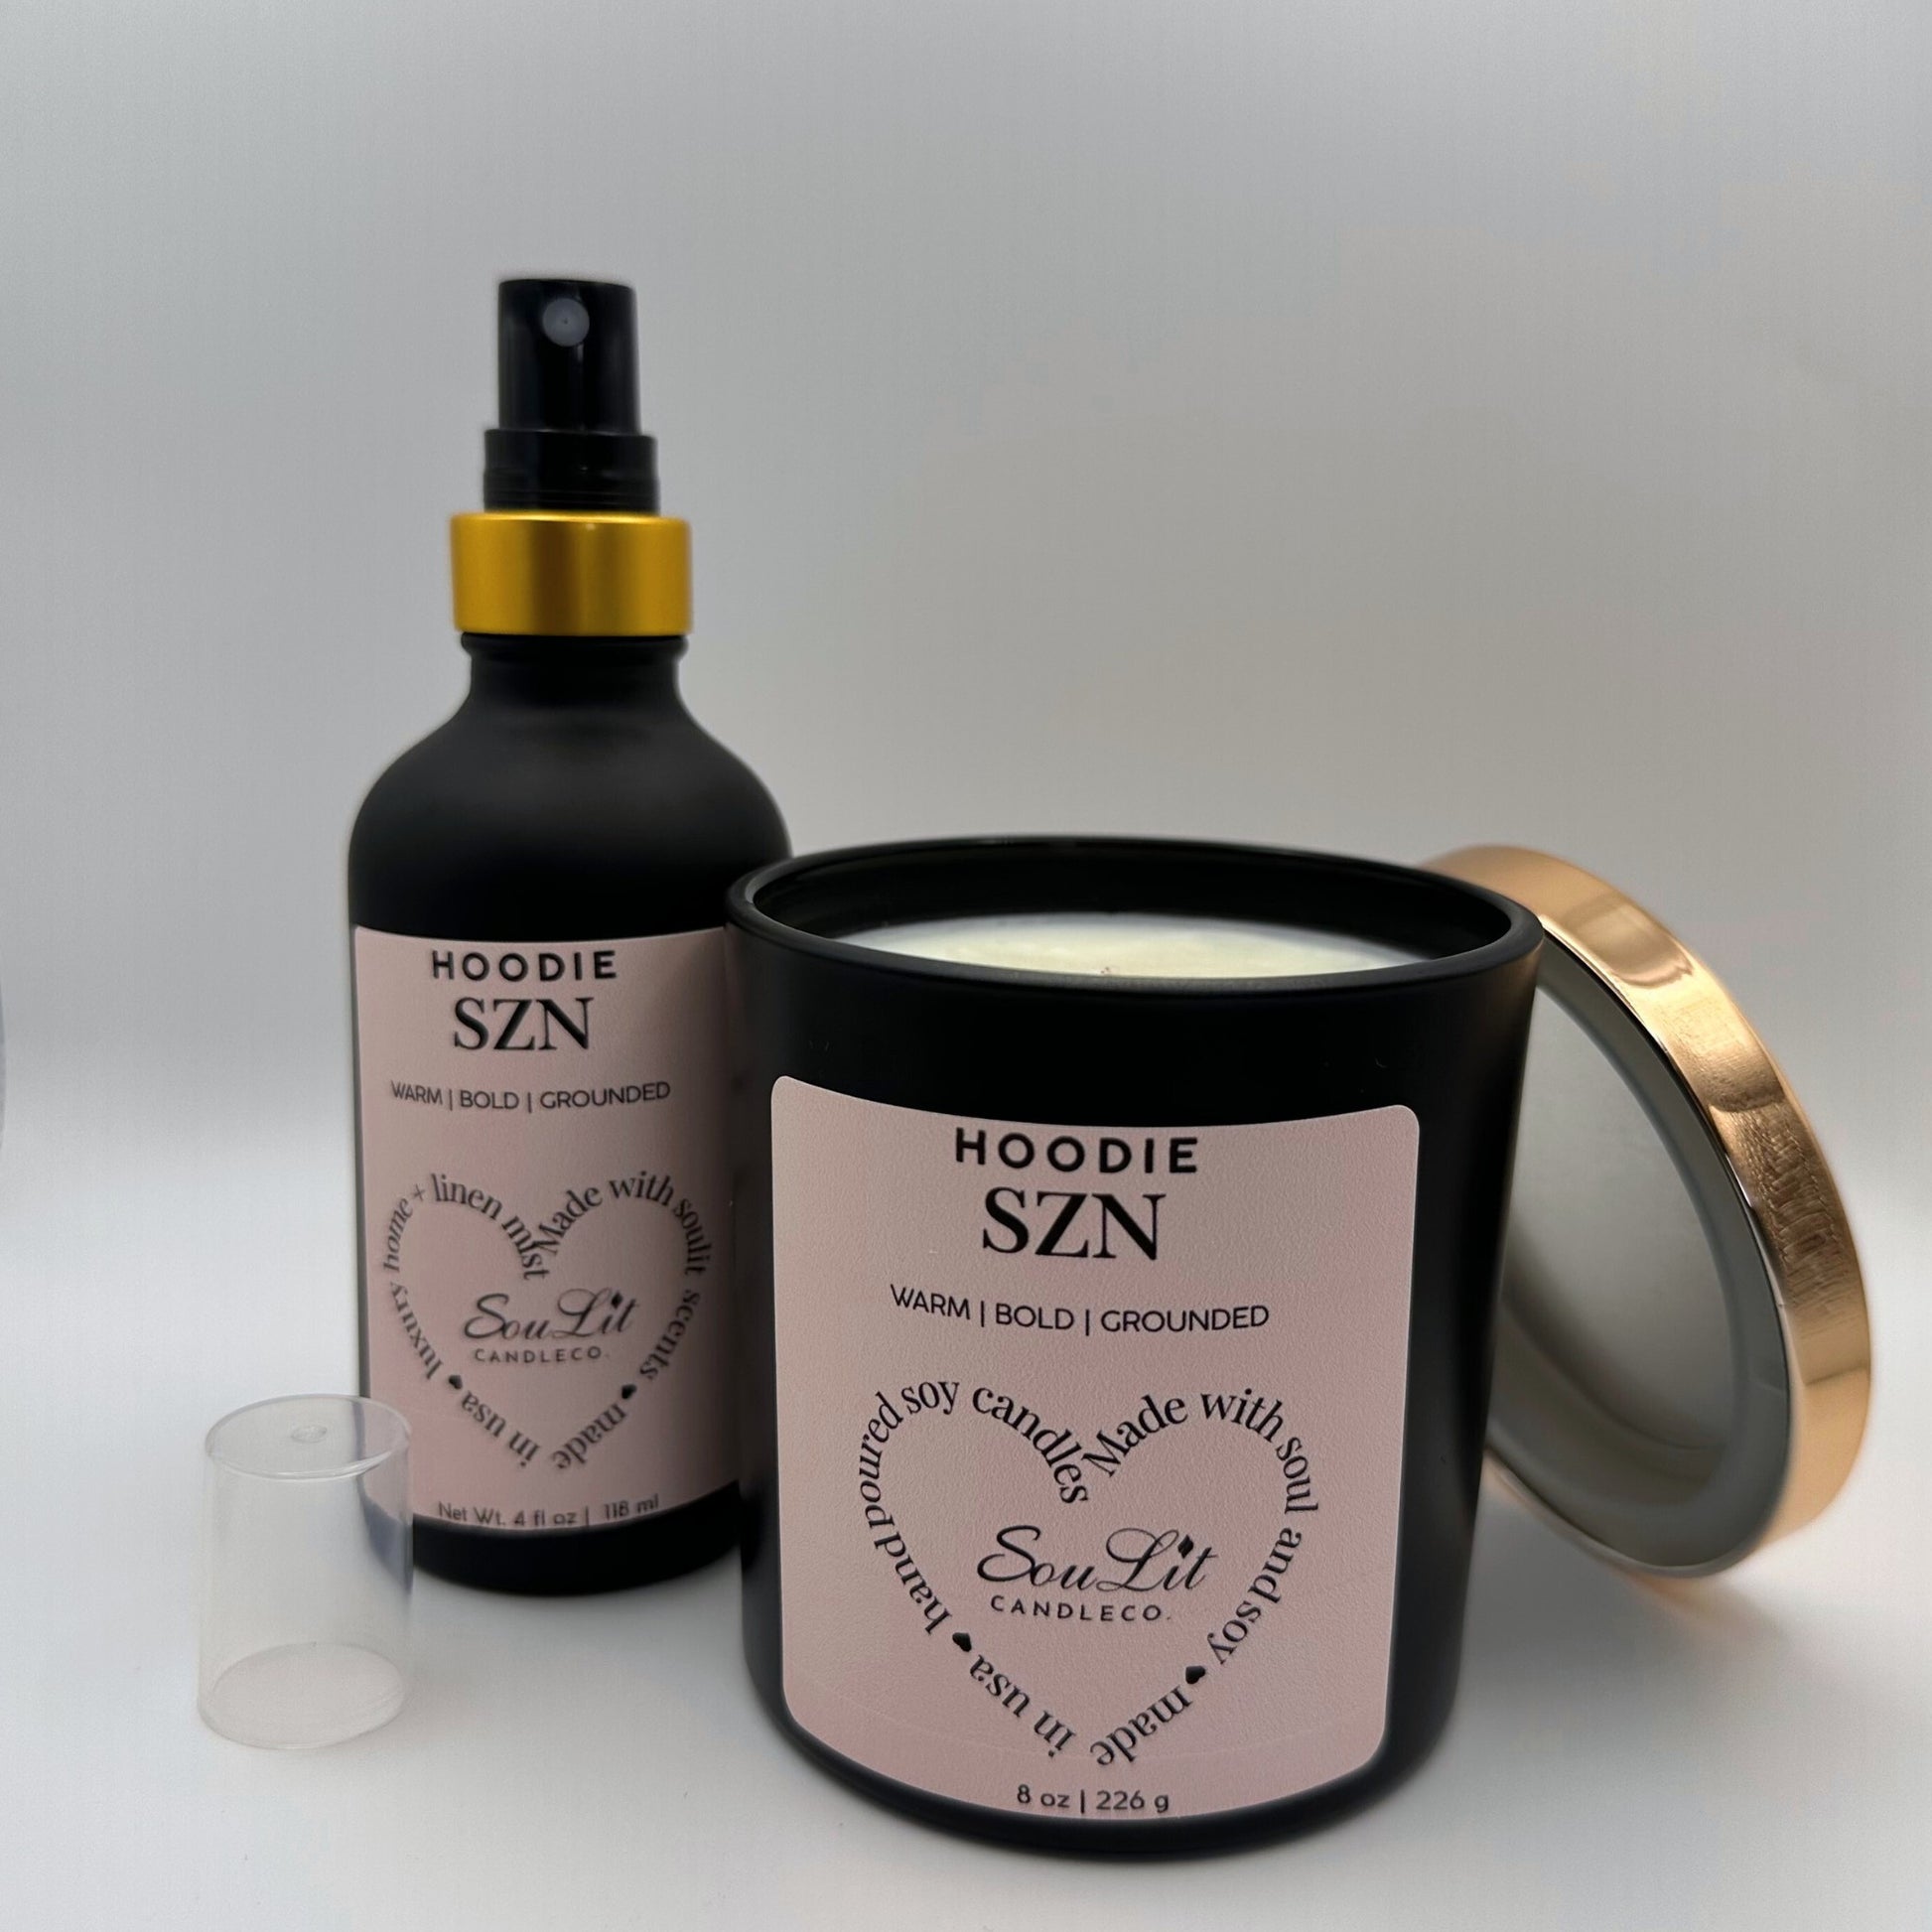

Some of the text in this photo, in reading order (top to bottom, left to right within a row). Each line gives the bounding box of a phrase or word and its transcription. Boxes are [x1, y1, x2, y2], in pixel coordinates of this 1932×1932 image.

[431, 949, 618, 982] HOODIE
[454, 996, 594, 1051] SZN
[390, 1080, 443, 1106] WARM
[460, 1090, 519, 1110] BOLD
[539, 1081, 672, 1110] GROUNDED
[955, 1126, 1199, 1174] HOODIE
[430, 1173, 503, 1221] linen
[609, 1171, 675, 1207] with
[383, 1197, 414, 1273] home
[531, 1187, 604, 1255] Made
[672, 1197, 712, 1277] soulit
[982, 1185, 1167, 1261] SZN
[501, 1214, 550, 1281] mist
[389, 1281, 443, 1380] luxury
[890, 1283, 971, 1320] WARM
[995, 1303, 1075, 1330] BOLD
[1100, 1305, 1270, 1332] GROUNDED
[639, 1289, 701, 1380] scents
[461, 1390, 508, 1439] usa
[551, 1401, 627, 1469] made
[508, 1431, 542, 1467] in
[438, 1500, 468, 1522] Net
[473, 1506, 505, 1526] Wt.
[513, 1509, 526, 1526] 4
[533, 1509, 545, 1526] fl
[552, 1511, 577, 1525] oz
[604, 1499, 630, 1521] 118
[636, 1492, 659, 1512] ml
[859, 1381, 1319, 1766] Made with soul and soy made in usa hand poured soy candles
[1017, 1784, 1032, 1805] 8
[1039, 1792, 1070, 1809] oz
[1096, 1790, 1146, 1811] 226
[1154, 1794, 1170, 1814] g
